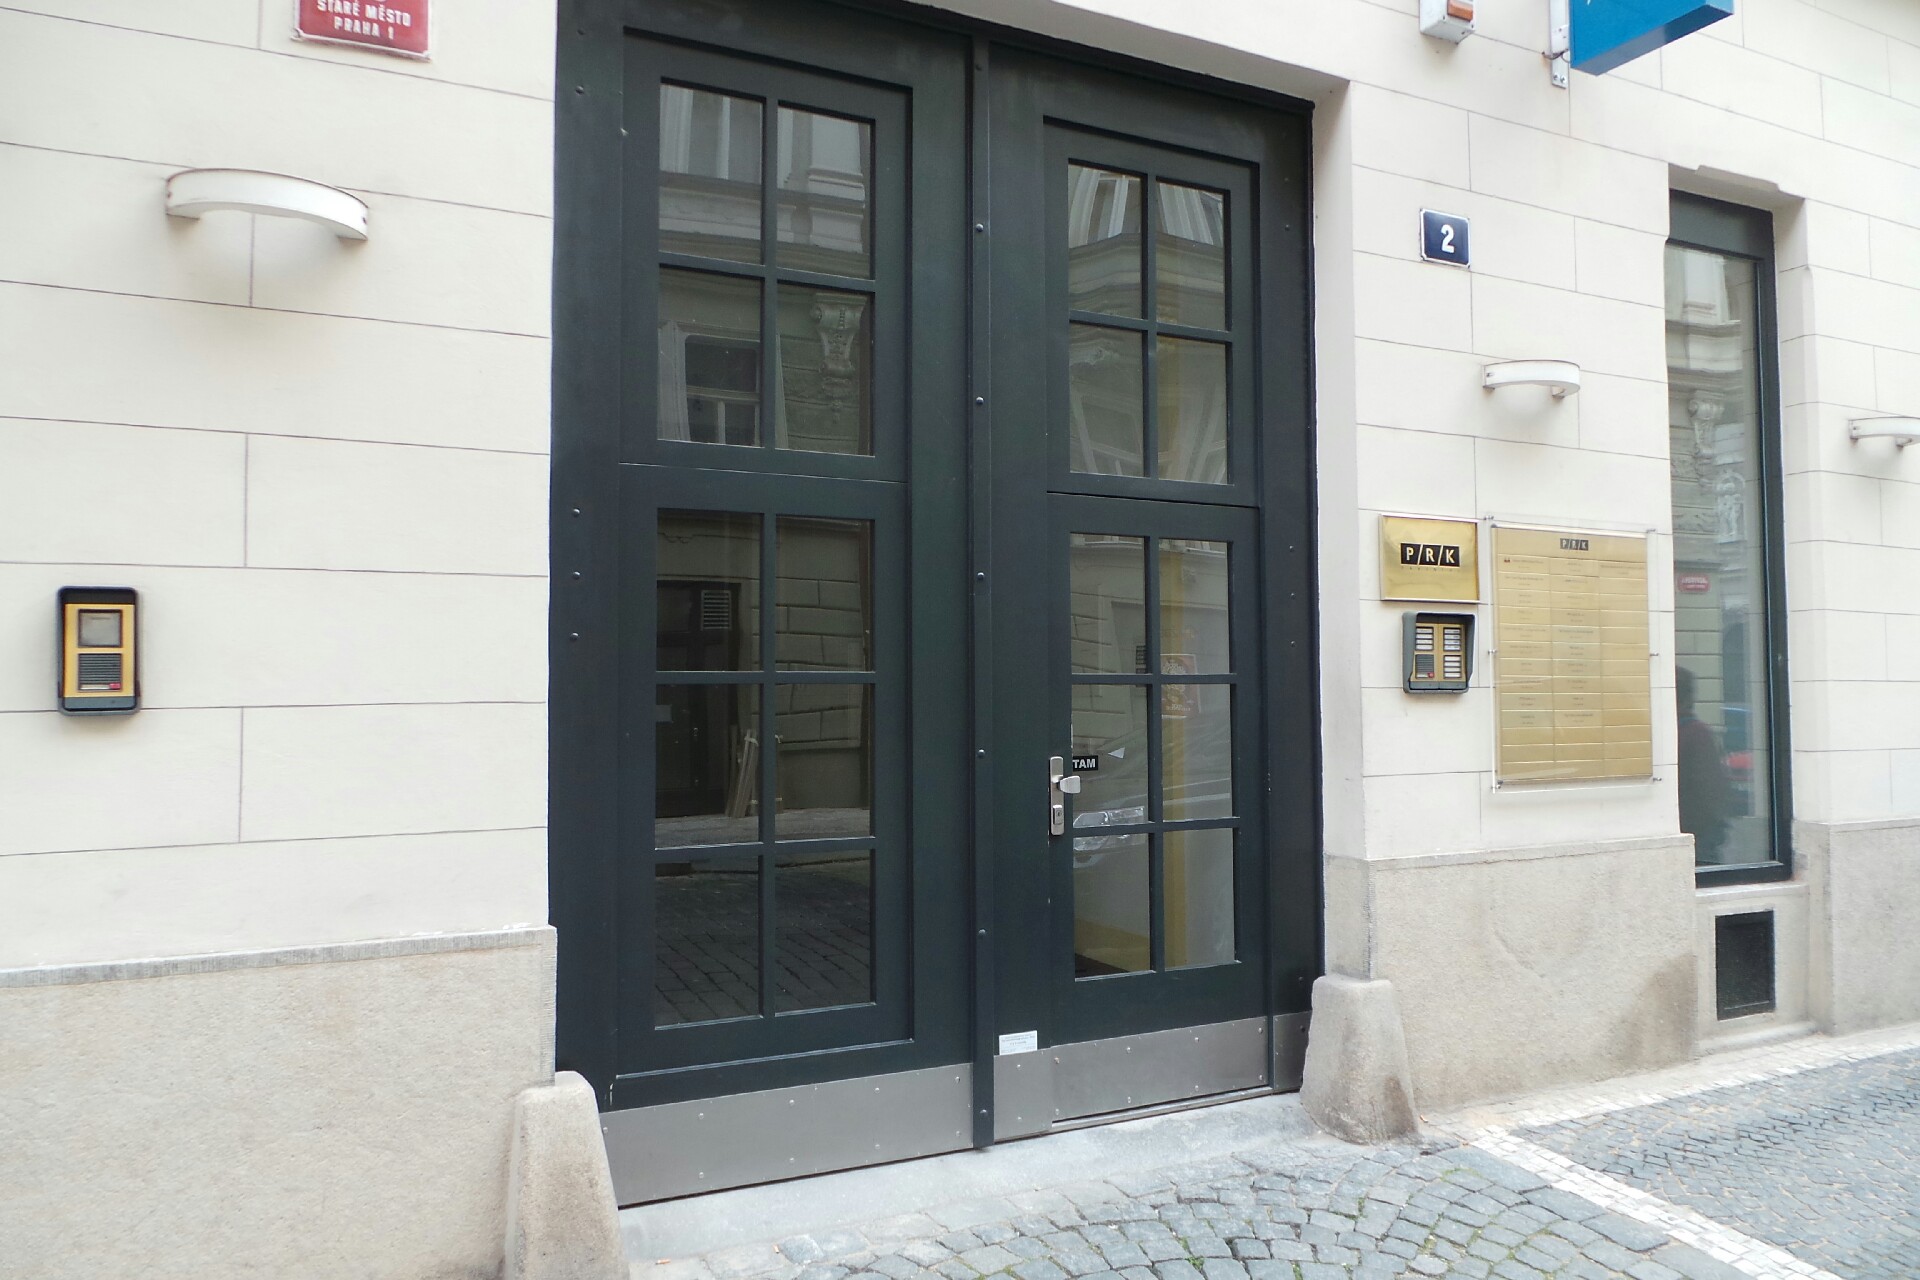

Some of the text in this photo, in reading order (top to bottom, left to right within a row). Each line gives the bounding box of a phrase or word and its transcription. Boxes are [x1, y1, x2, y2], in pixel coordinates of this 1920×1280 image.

[334, 16, 380, 37] PRAHA
[365, 4, 411, 27] MĚSTO
[1441, 224, 1455, 253] 2
[1072, 758, 1096, 769] TAM
